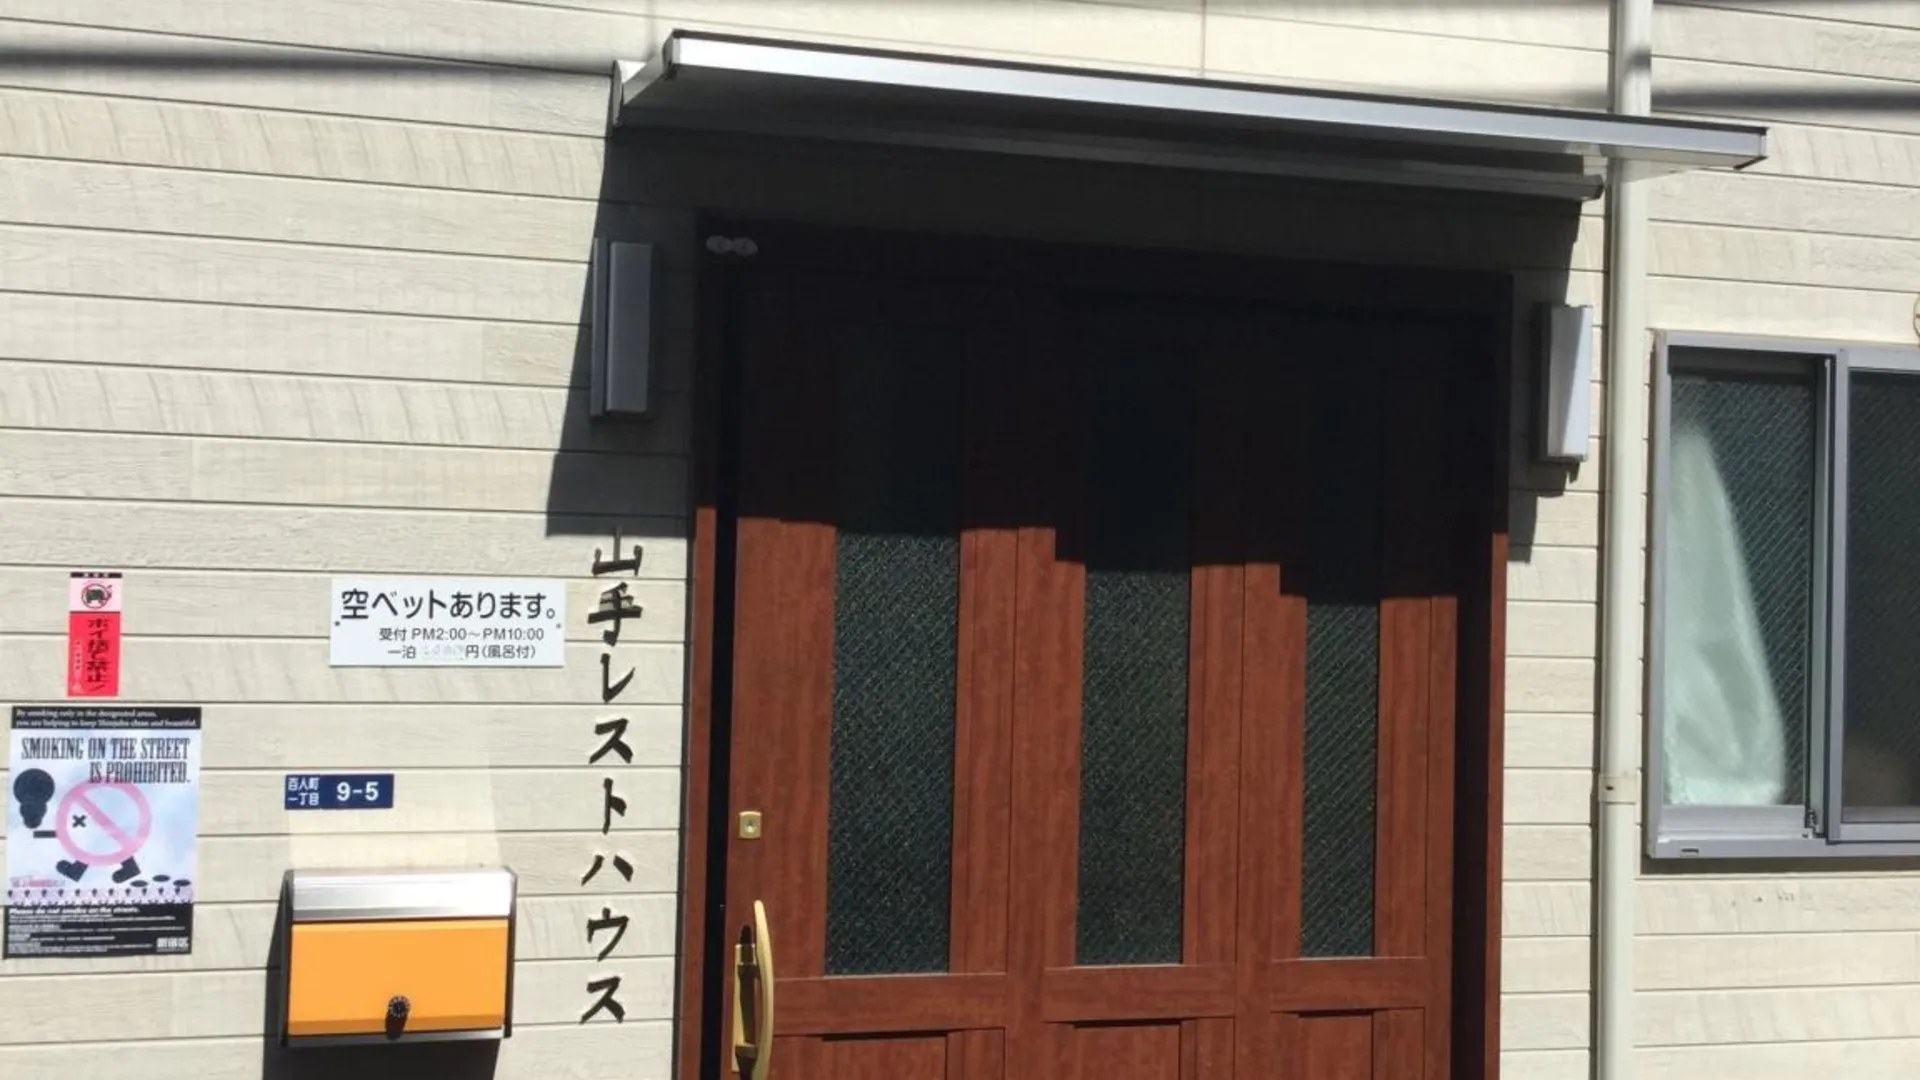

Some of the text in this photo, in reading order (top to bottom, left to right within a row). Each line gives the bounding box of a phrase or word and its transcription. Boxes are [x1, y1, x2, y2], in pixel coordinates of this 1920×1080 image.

[341, 588, 556, 619] 空ベットあります。
[378, 628, 407, 642] 受付
[387, 644, 416, 659] 一泊
[21, 737, 190, 760] SMOKING ON THE STREET
[89, 761, 191, 784] IS PROHIBITED.
[577, 525, 644, 1025] 山手レストハウス
[288, 777, 320, 791] 百人町
[336, 781, 379, 801] 9-5
[288, 792, 319, 806] 一丁目
